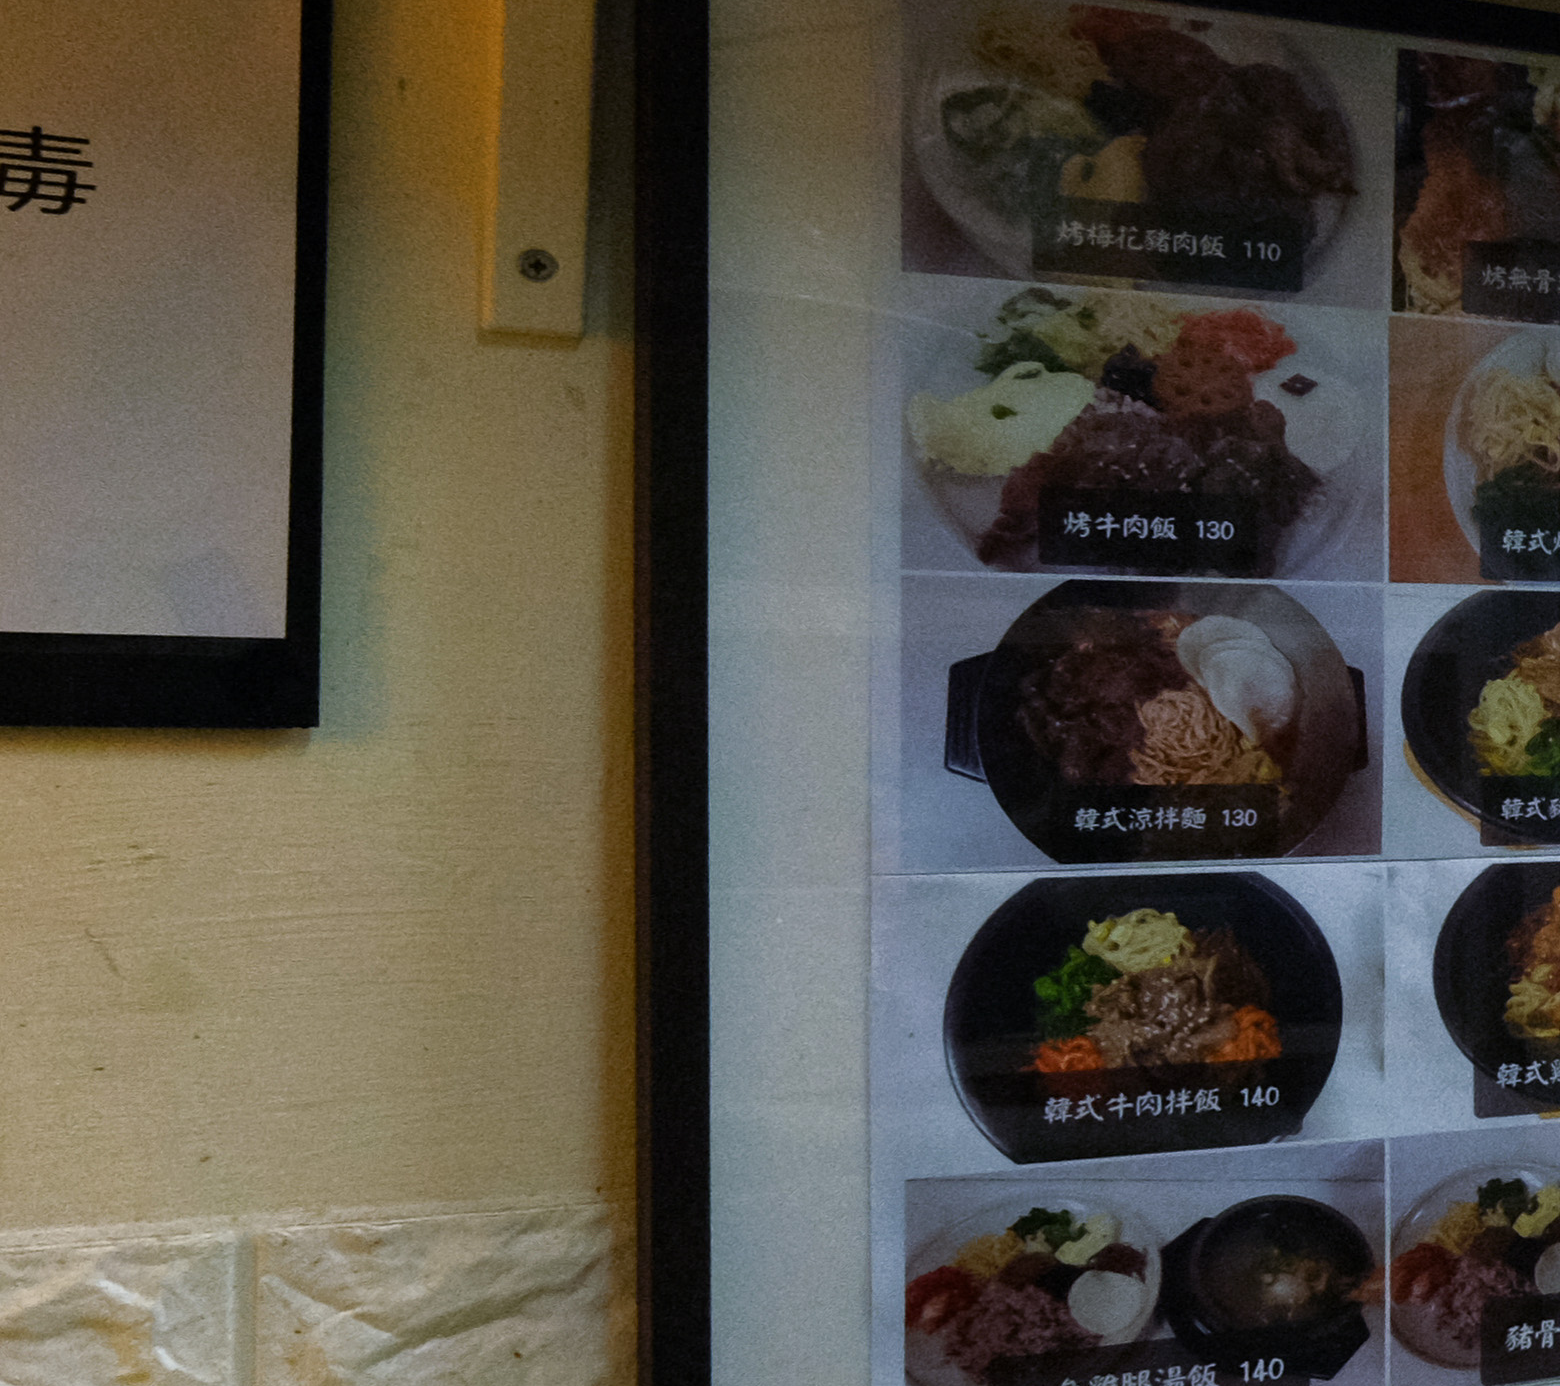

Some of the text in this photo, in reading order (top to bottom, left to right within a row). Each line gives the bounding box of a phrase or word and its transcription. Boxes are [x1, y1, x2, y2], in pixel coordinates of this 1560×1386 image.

[1243, 238, 1282, 262] 110
[1062, 509, 1234, 542] 烤牛肉飯 130
[1074, 806, 1258, 832] 韓式涼拌麵 130
[1045, 1085, 1280, 1125] 韓式牛肉拌飯 140
[1238, 1358, 1284, 1383] 140
